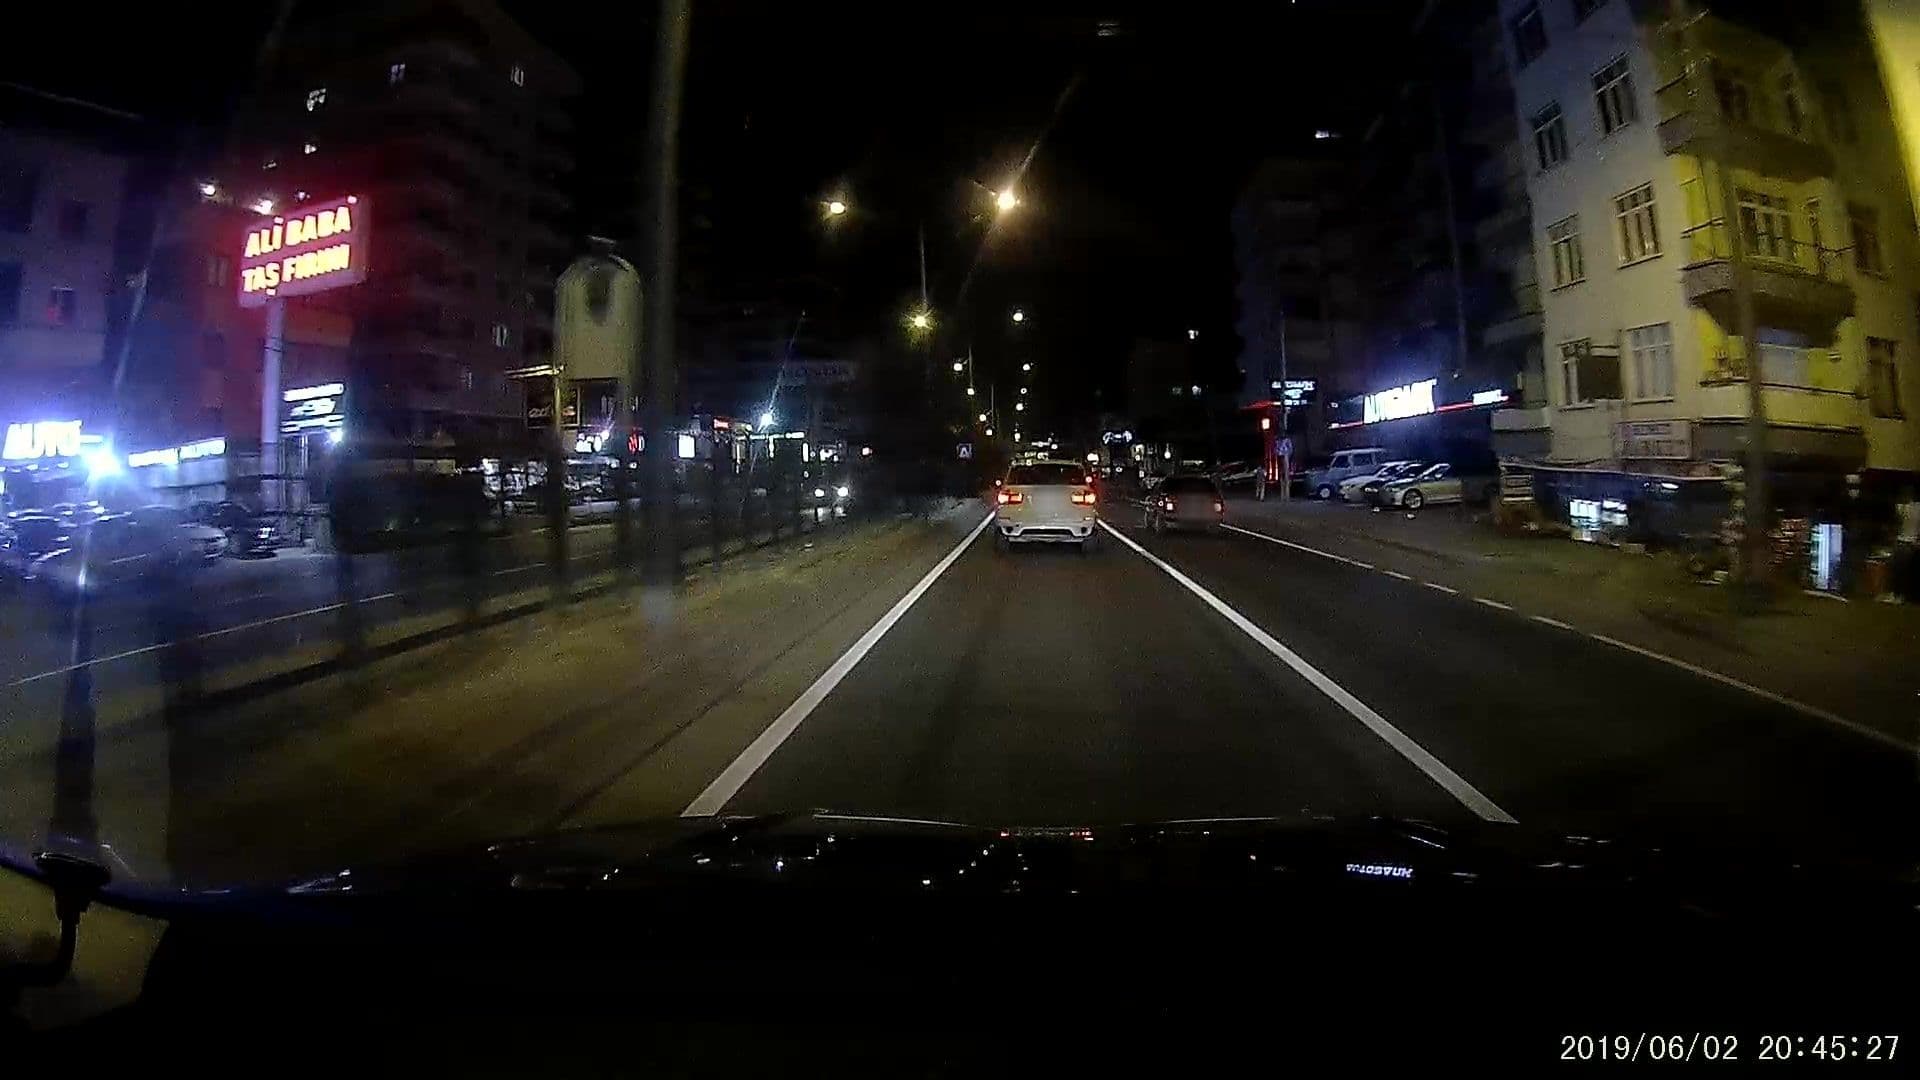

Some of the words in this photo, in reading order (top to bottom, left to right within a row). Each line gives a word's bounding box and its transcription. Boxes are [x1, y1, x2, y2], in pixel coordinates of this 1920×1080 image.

[245, 217, 284, 257] ALİ
[286, 206, 351, 245] BABA
[242, 262, 280, 296] TAŞ
